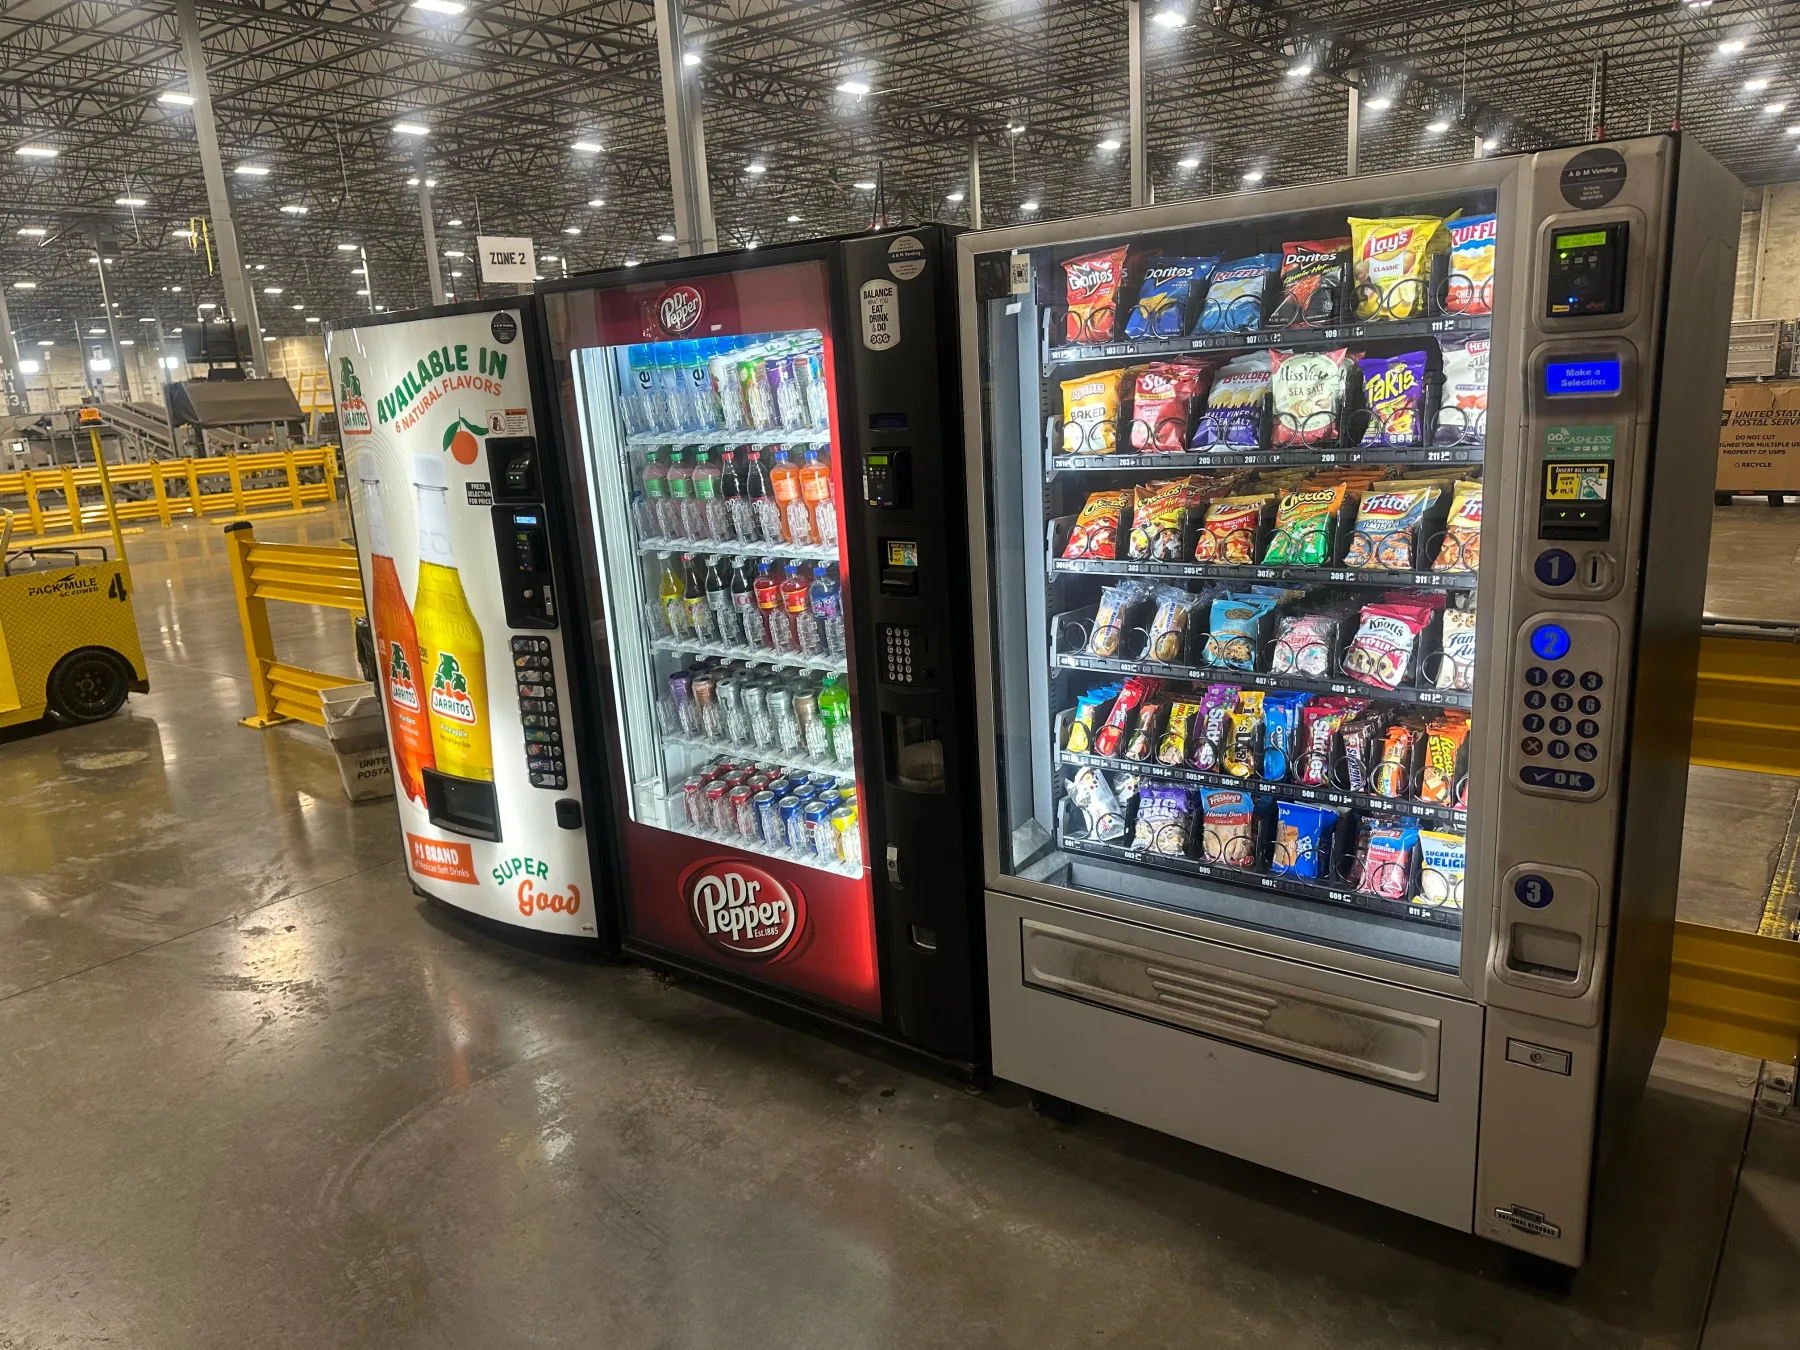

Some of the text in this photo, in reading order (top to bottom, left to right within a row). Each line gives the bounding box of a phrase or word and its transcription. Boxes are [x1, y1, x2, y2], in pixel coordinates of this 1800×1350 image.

[1370, 231, 1408, 256] Lay's
[490, 252, 526, 264] ZONE 2
[1286, 253, 1337, 265] Doritos
[1144, 267, 1194, 280] Doritos
[1310, 264, 1329, 273] Hot
[1374, 264, 1398, 272] CLASSIC
[1069, 269, 1113, 290] Doritos
[672, 291, 689, 310] Dr
[863, 288, 893, 299] BALANCE
[661, 295, 702, 329] Pepper
[871, 304, 883, 314] EAT
[869, 314, 888, 323] DRINK
[877, 323, 886, 331] DO
[1432, 322, 1442, 331] 111
[1222, 371, 1271, 384] BOULDER
[1278, 366, 1305, 382] Miss
[376, 344, 508, 425] AVAILABLE IN
[1366, 370, 1418, 404] Takis
[1561, 378, 1605, 386] Selection
[1071, 382, 1105, 401] RUFFLES
[1288, 384, 1324, 396] SEA SALT
[395, 375, 502, 433] 6 NATURAL FLAVORS
[1070, 406, 1107, 420] BAKED
[1205, 410, 1225, 418] MALT
[1562, 436, 1612, 444] CASHLESS
[1119, 458, 1130, 466] 203
[1245, 456, 1256, 464] 207
[1428, 452, 1440, 461] 211
[1055, 460, 1067, 468] 201
[1138, 485, 1182, 507] Cheetos
[1164, 498, 1179, 507] Hot
[1280, 490, 1336, 512] Cheetos
[1362, 494, 1416, 513] Fritos
[1223, 517, 1250, 528] ORIGINAL
[1548, 556, 1560, 580] 1
[70, 586, 98, 596] POWER
[108, 572, 128, 602] 4
[1369, 619, 1404, 637] Knott's
[1544, 632, 1558, 654] 2
[1533, 670, 1596, 688] 1 2 3
[393, 684, 416, 705] JARRITOS
[1420, 693, 1431, 701] 411
[434, 696, 471, 716] JARRITOS
[1531, 693, 1595, 712] 4 5 6
[440, 722, 468, 738] Pineapple
[1531, 716, 1593, 735] 7 8 9
[1555, 743, 1564, 755] 0
[1441, 736, 1455, 777] Reese's
[1346, 747, 1360, 790] SNICKERS
[1554, 772, 1582, 787] OK
[1140, 798, 1178, 807] BIG
[1208, 793, 1242, 805] Freshley's
[1137, 806, 1180, 819] TEXAS
[1412, 806, 1423, 815] 511
[414, 842, 459, 865] #1 BRAND
[418, 860, 437, 872] Mexican
[437, 865, 449, 874] Soft
[450, 866, 470, 878] Drinks
[492, 857, 549, 886] SUPER
[1200, 866, 1210, 874] 605
[724, 872, 761, 906] Dr
[1329, 892, 1342, 900] 609
[1526, 881, 1541, 903] 3
[518, 879, 580, 916] Good
[693, 875, 787, 942] Pepper
[1409, 907, 1420, 915] 611
[1498, 1213, 1527, 1227] NATIONAL
